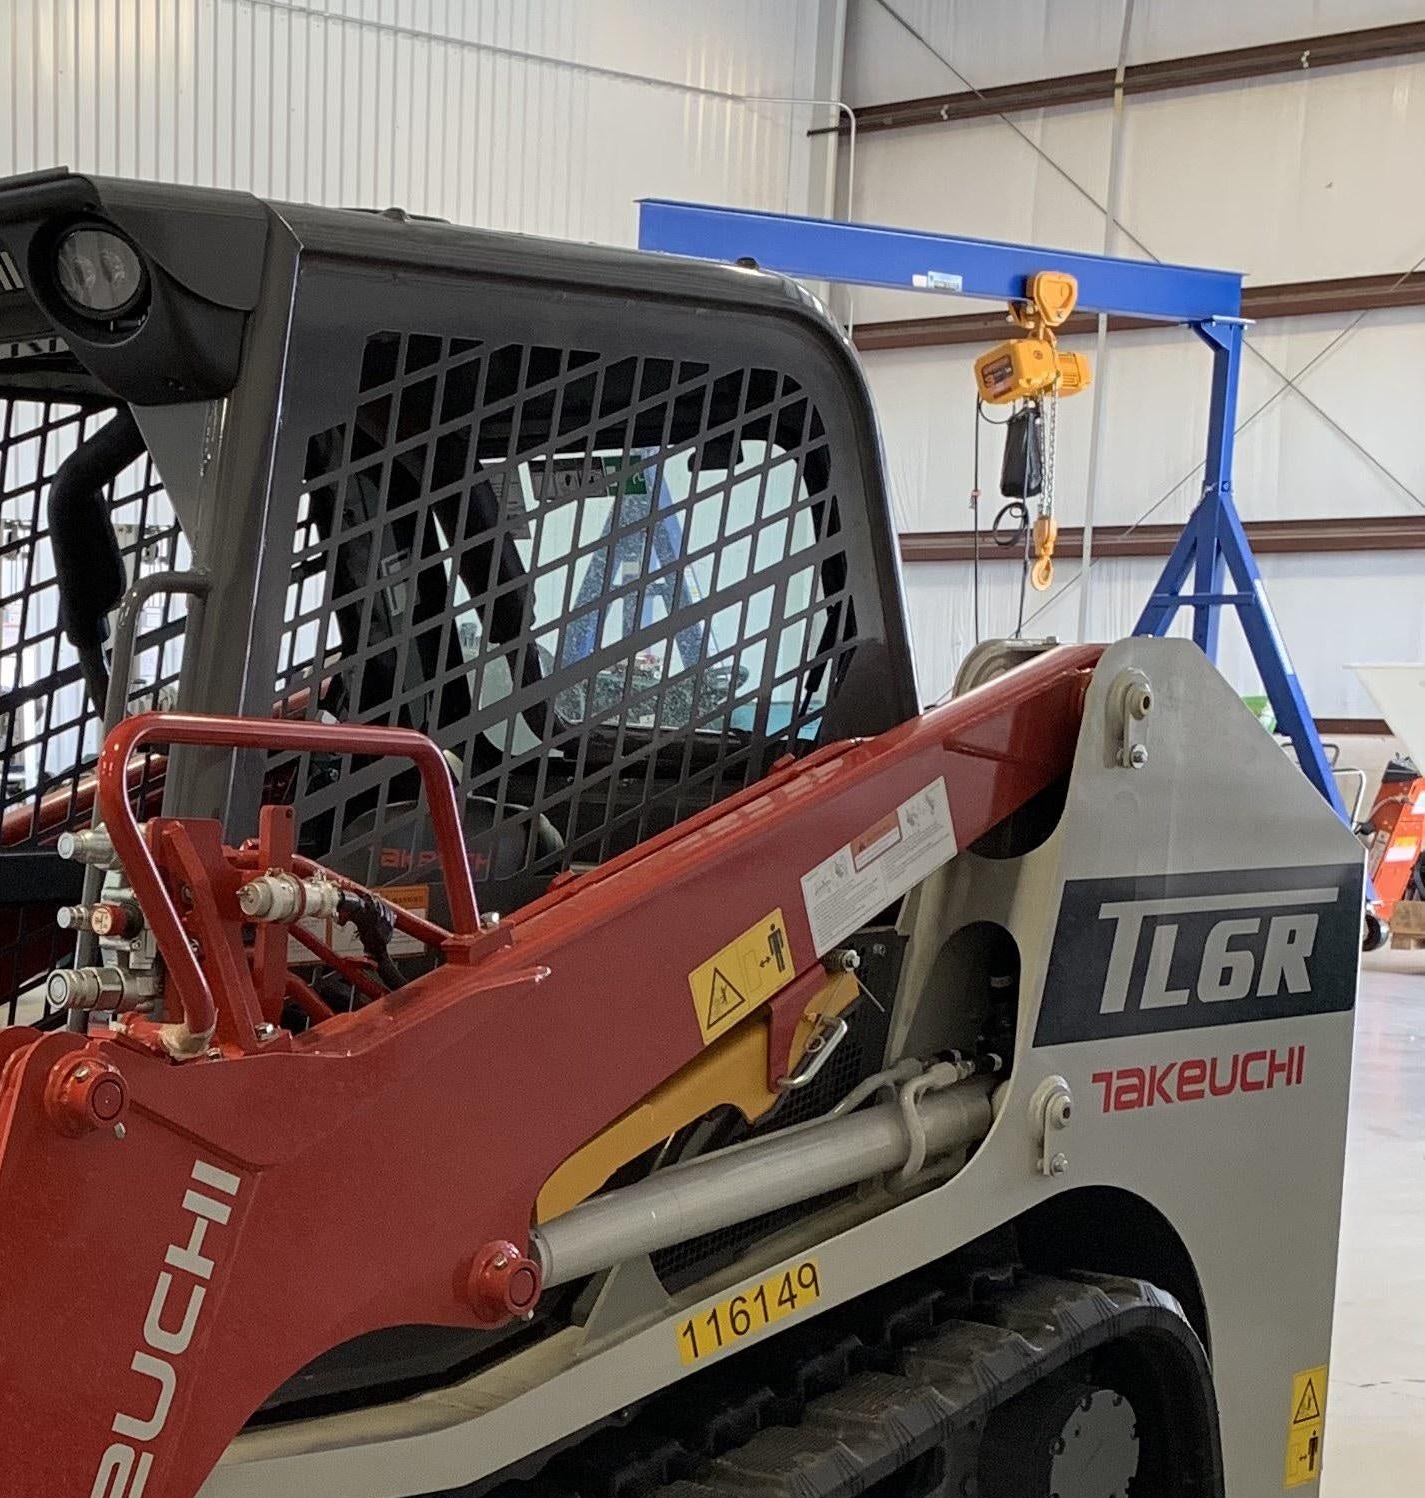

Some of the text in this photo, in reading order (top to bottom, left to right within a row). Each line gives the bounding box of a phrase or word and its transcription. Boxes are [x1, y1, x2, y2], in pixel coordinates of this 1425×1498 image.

[1097, 886, 1339, 1014] TL6R
[1092, 1046, 1305, 1112] TAKEUCHI
[682, 1262, 821, 1358] 116149
